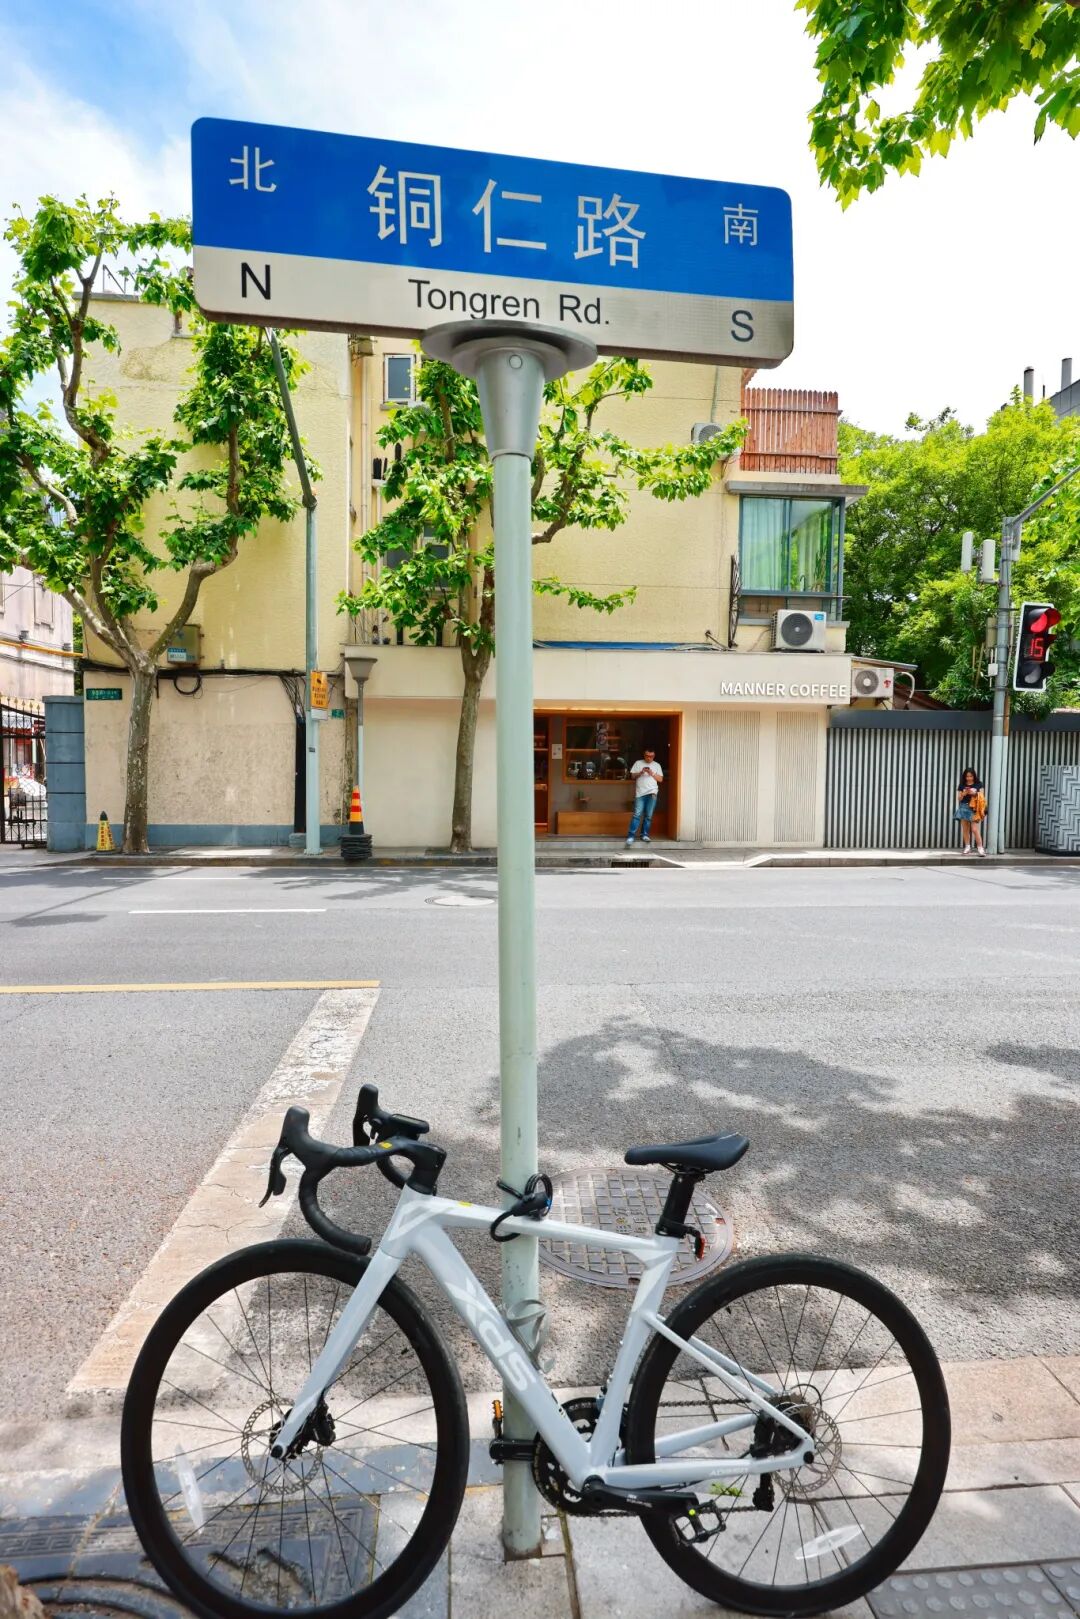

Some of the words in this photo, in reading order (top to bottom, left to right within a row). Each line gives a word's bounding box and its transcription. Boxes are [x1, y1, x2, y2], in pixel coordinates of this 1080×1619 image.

[229, 145, 277, 193] 北
[367, 164, 647, 269] 铜仁路
[723, 203, 759, 247] 南
[240, 262, 272, 300] N
[408, 279, 541, 320] Tongren
[558, 293, 611, 326] Rd.
[730, 310, 754, 343] S
[1030, 637, 1044, 658] 15
[720, 681, 785, 696] MANNER
[790, 683, 848, 698] COFFEE
